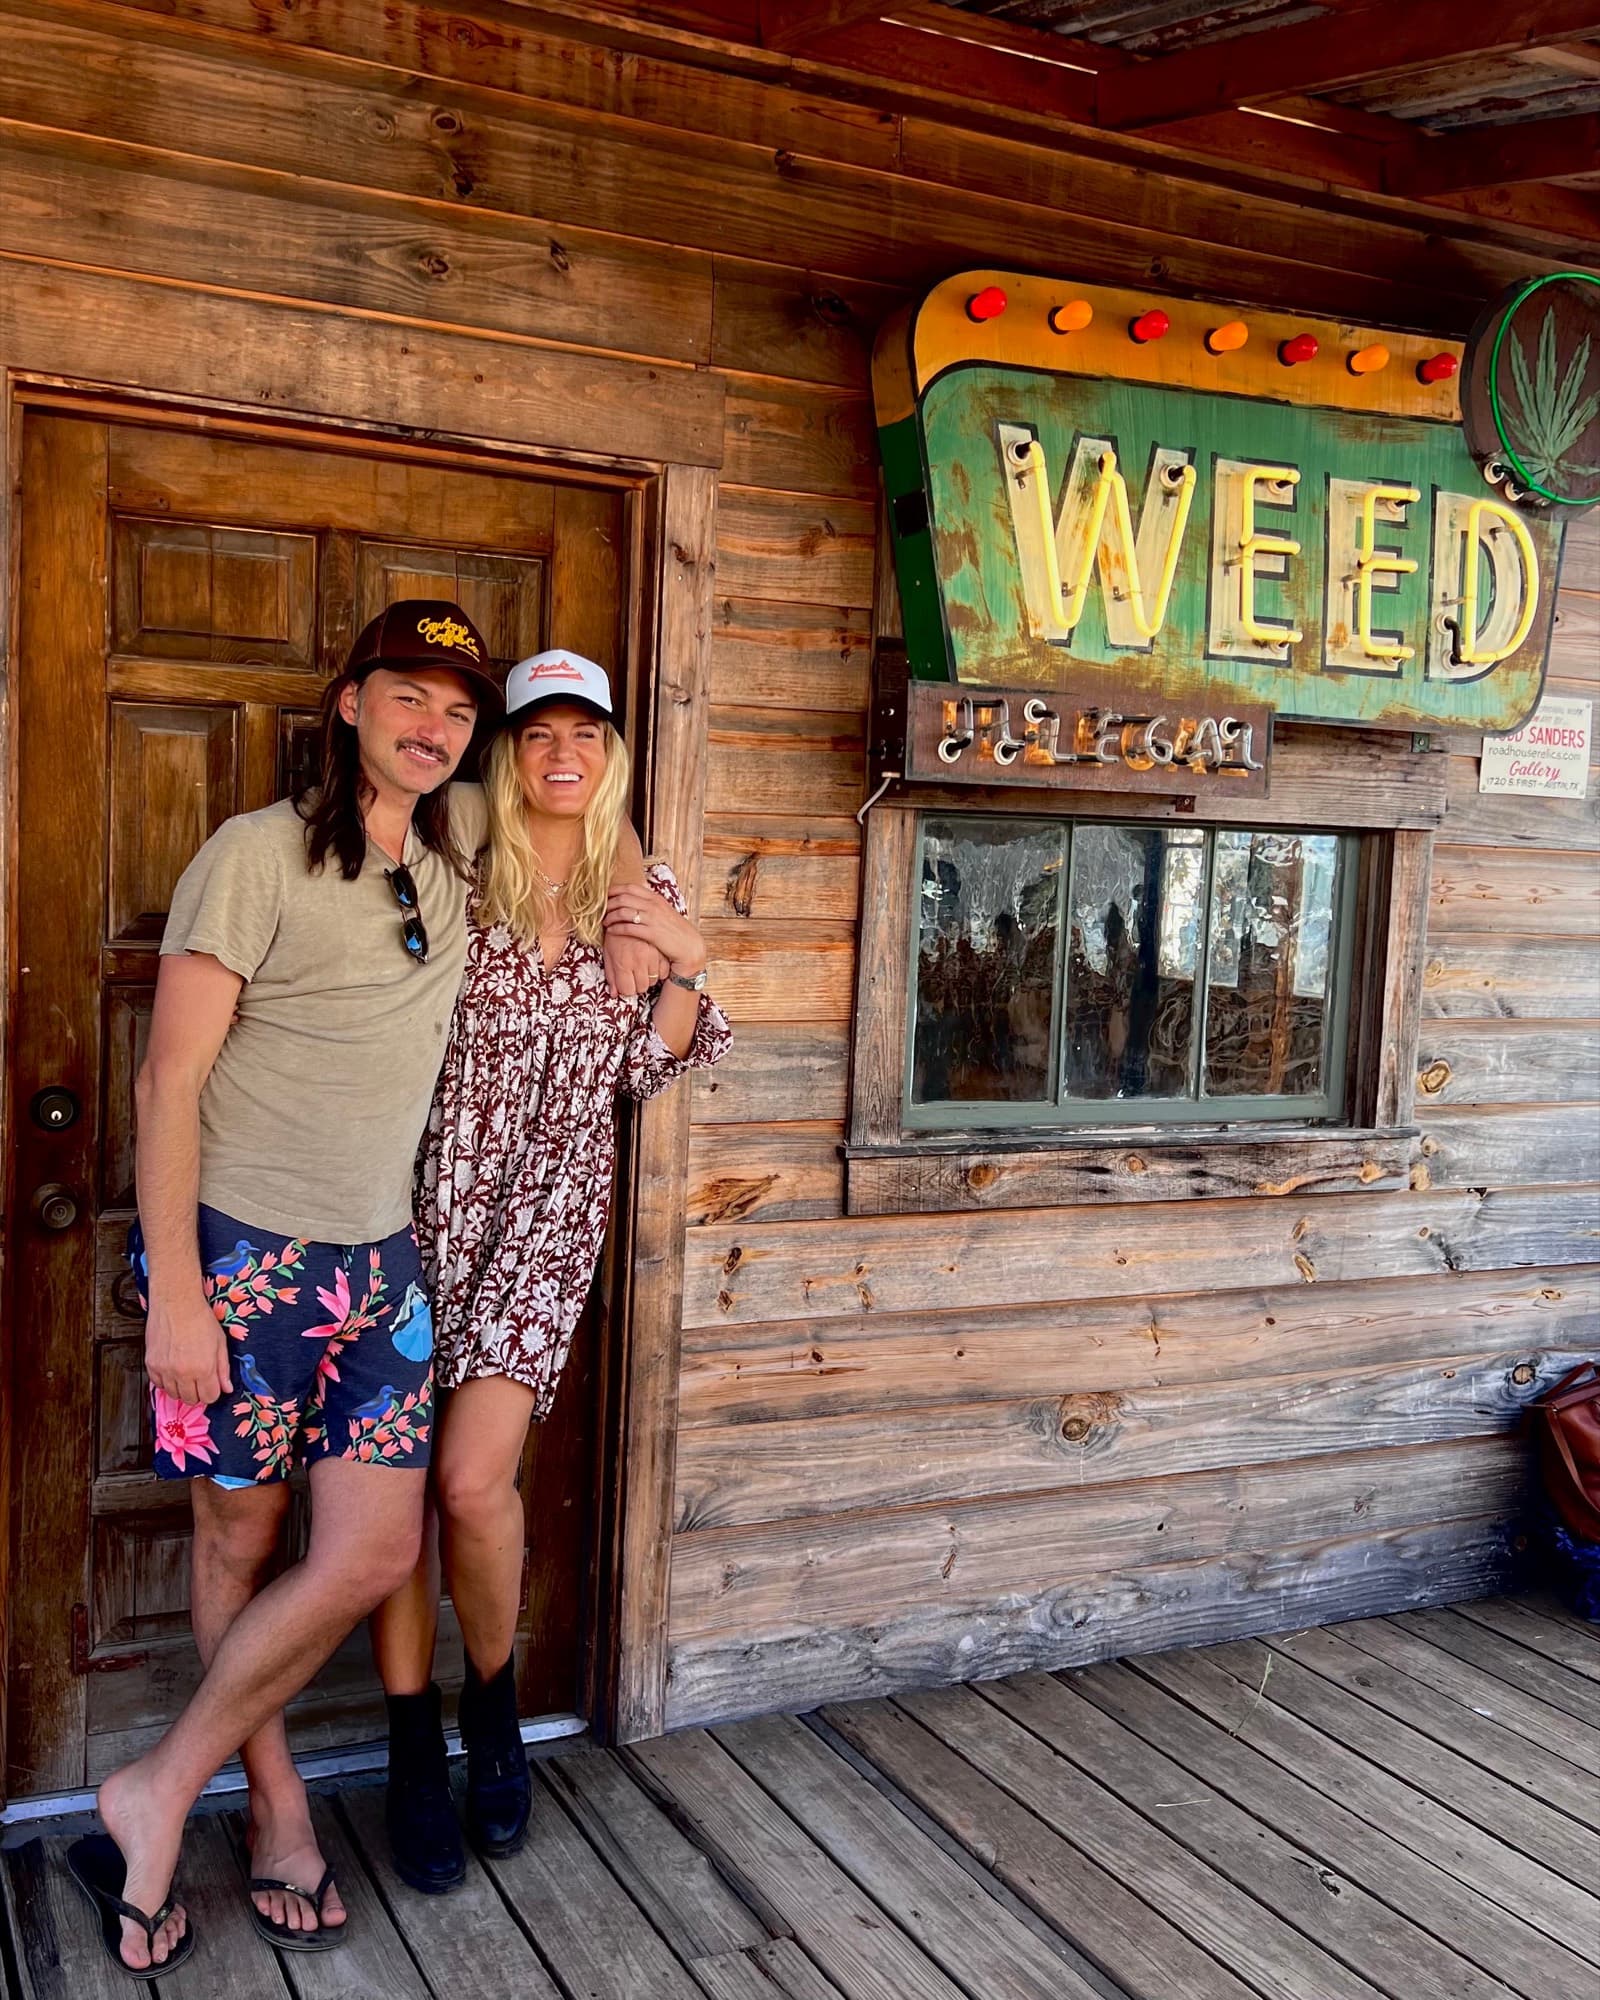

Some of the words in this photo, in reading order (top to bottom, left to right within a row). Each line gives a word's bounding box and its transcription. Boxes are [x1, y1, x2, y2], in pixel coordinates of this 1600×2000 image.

[998, 421, 1541, 683] WEED
[941, 697, 1263, 777] ILLEGAL
[1528, 726, 1585, 748] SANDERS
[1488, 745, 1582, 760] roadhouserelics.com
[1509, 760, 1561, 781] Gallery
[1487, 777, 1506, 786] 1720
